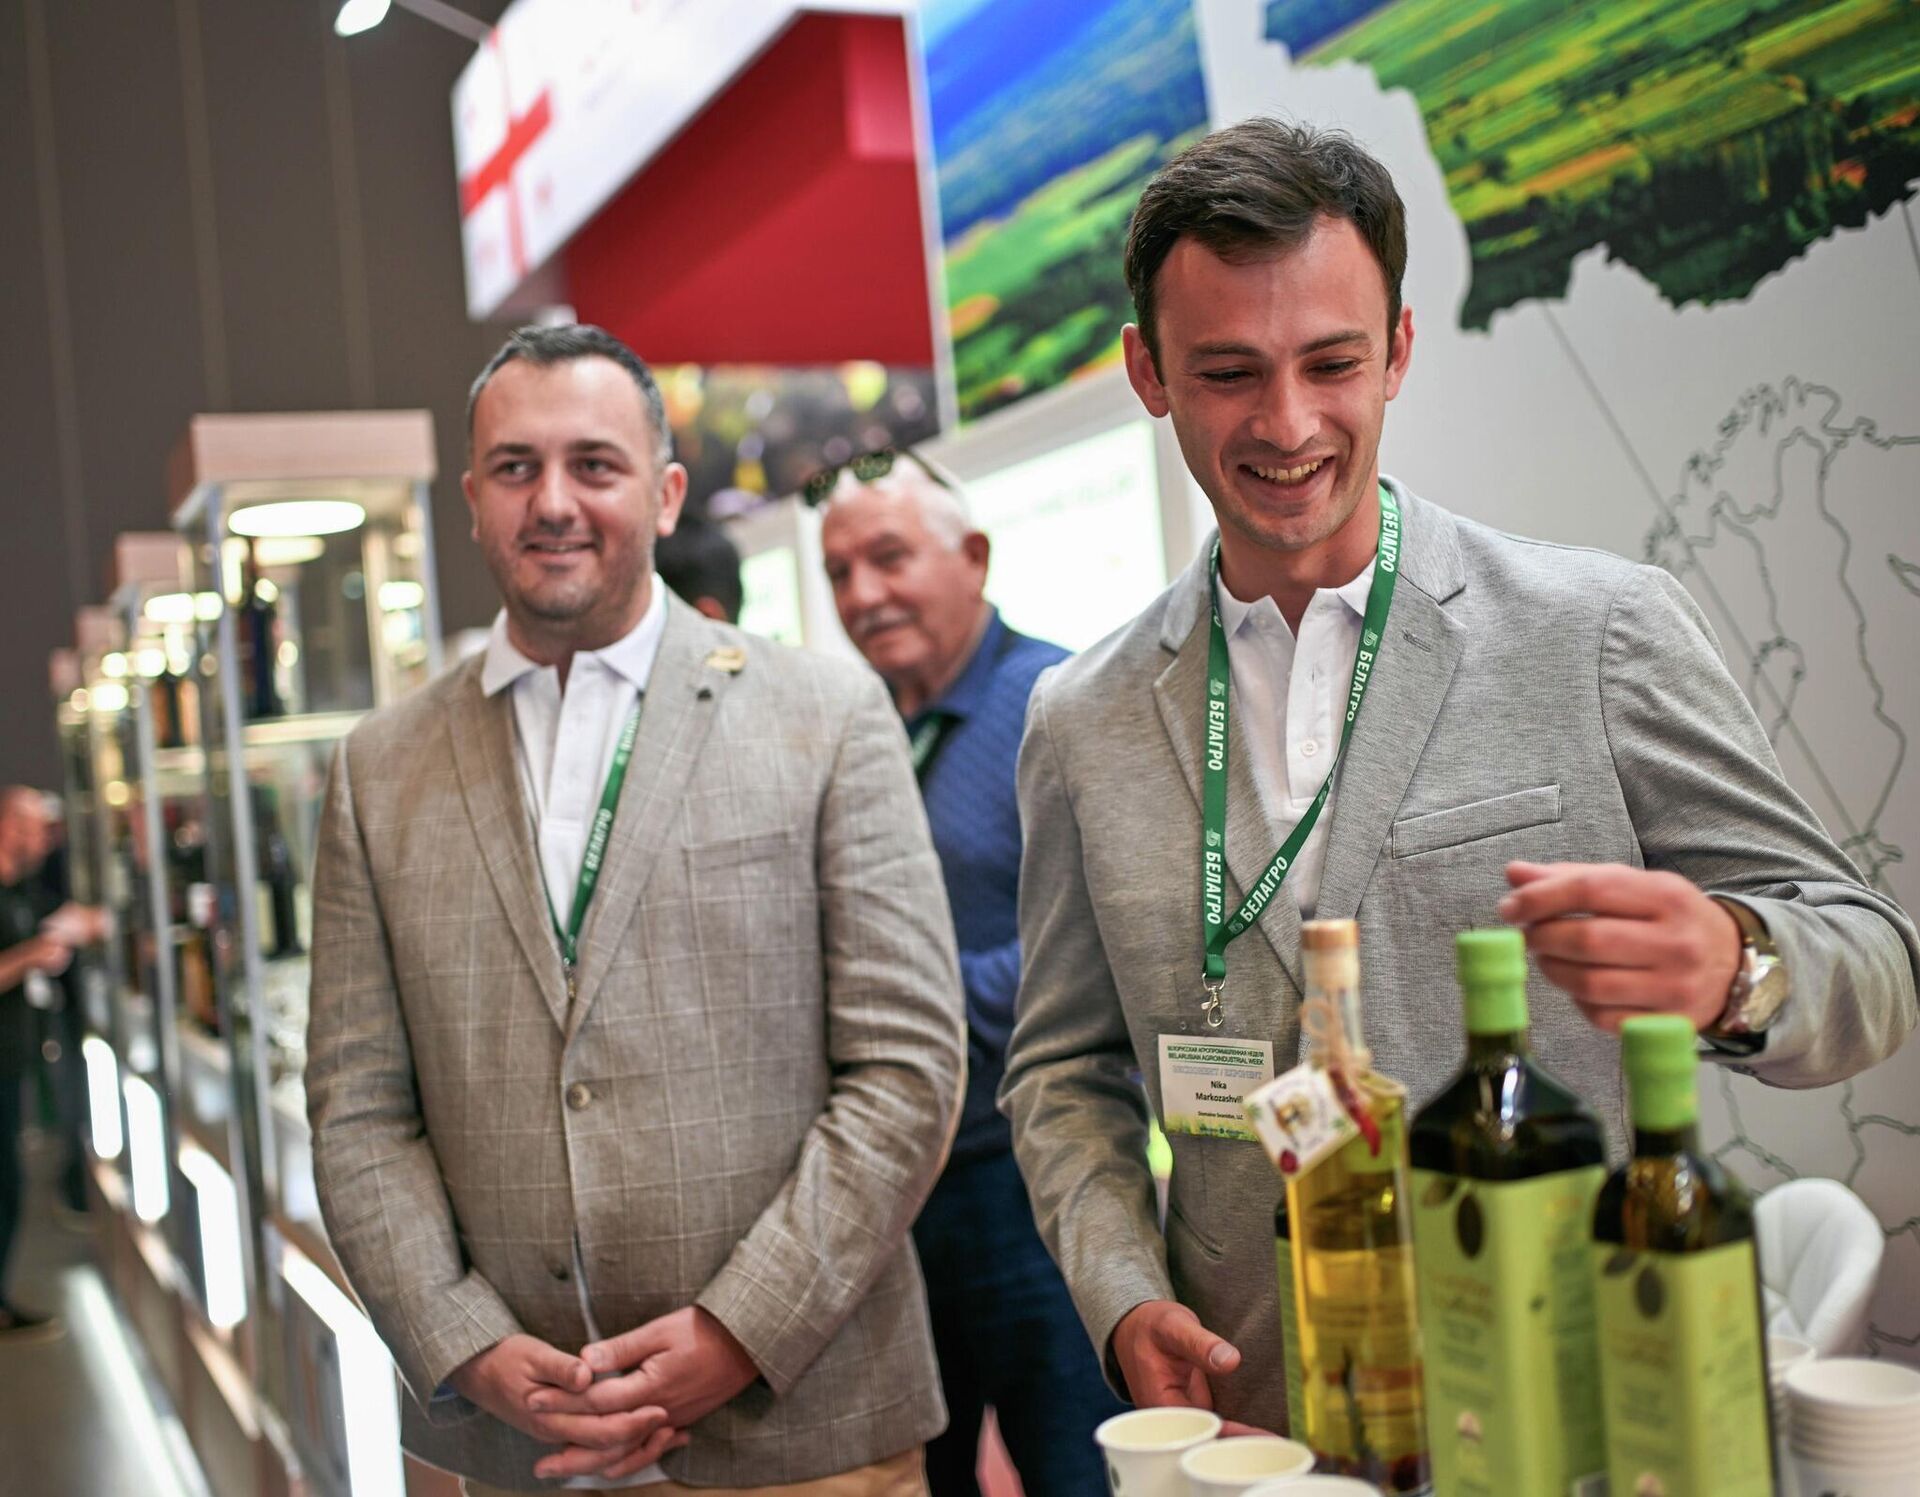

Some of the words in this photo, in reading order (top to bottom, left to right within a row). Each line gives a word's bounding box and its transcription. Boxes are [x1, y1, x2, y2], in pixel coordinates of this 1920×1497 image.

[1380, 508, 1399, 573] БЕЛАГРО
[1346, 650, 1373, 722] БЕЛАГРО
[1208, 700, 1224, 771] БЕЛАГРО
[1206, 851, 1222, 925] БЕЛАГРО
[1240, 856, 1288, 922] БЕЛАГРО
[1168, 1052, 1201, 1061] BELARUSIAN
[1202, 1055, 1248, 1065] AGROINDUSTRIAL
[1248, 1058, 1264, 1066] WEEK
[1210, 1080, 1227, 1089] Nika
